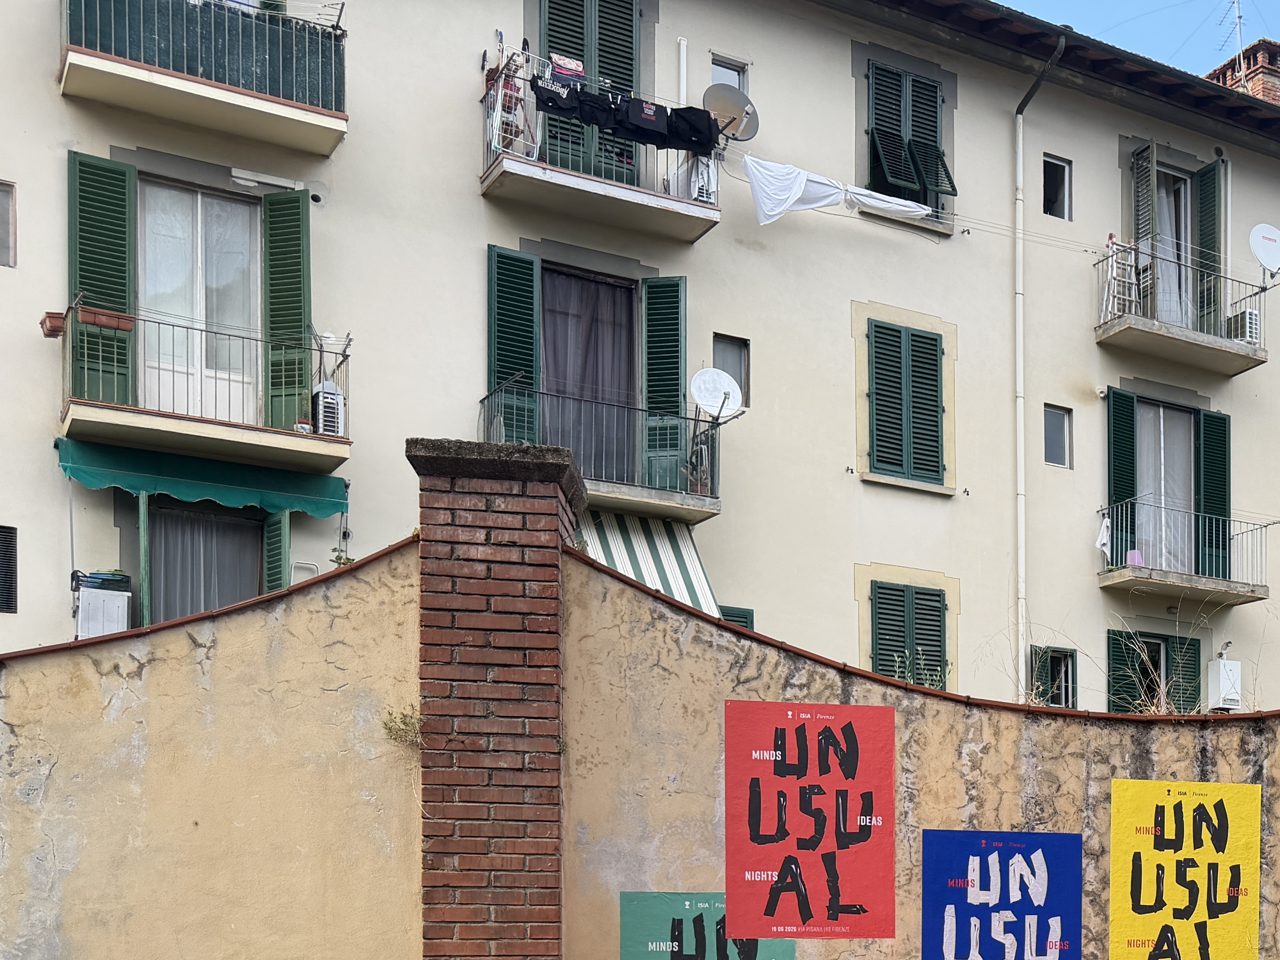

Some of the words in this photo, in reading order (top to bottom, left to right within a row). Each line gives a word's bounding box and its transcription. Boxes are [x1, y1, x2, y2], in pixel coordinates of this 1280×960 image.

[752, 750, 782, 761] MINDS
[774, 720, 859, 781] UN
[748, 777, 874, 851] USU
[857, 816, 883, 826] IDEAS
[1153, 798, 1229, 854] UN
[1135, 826, 1161, 836] MINDS
[745, 871, 778, 881] NIGHTS
[967, 848, 1048, 908] UN
[764, 851, 869, 925] AL
[947, 879, 976, 888] MINDS
[1130, 851, 1241, 921] USU
[1226, 887, 1249, 897] IDEAS
[648, 942, 679, 951] MINDS
[1046, 941, 1070, 950] IDEAS
[1127, 939, 1156, 948] NIGHTS
